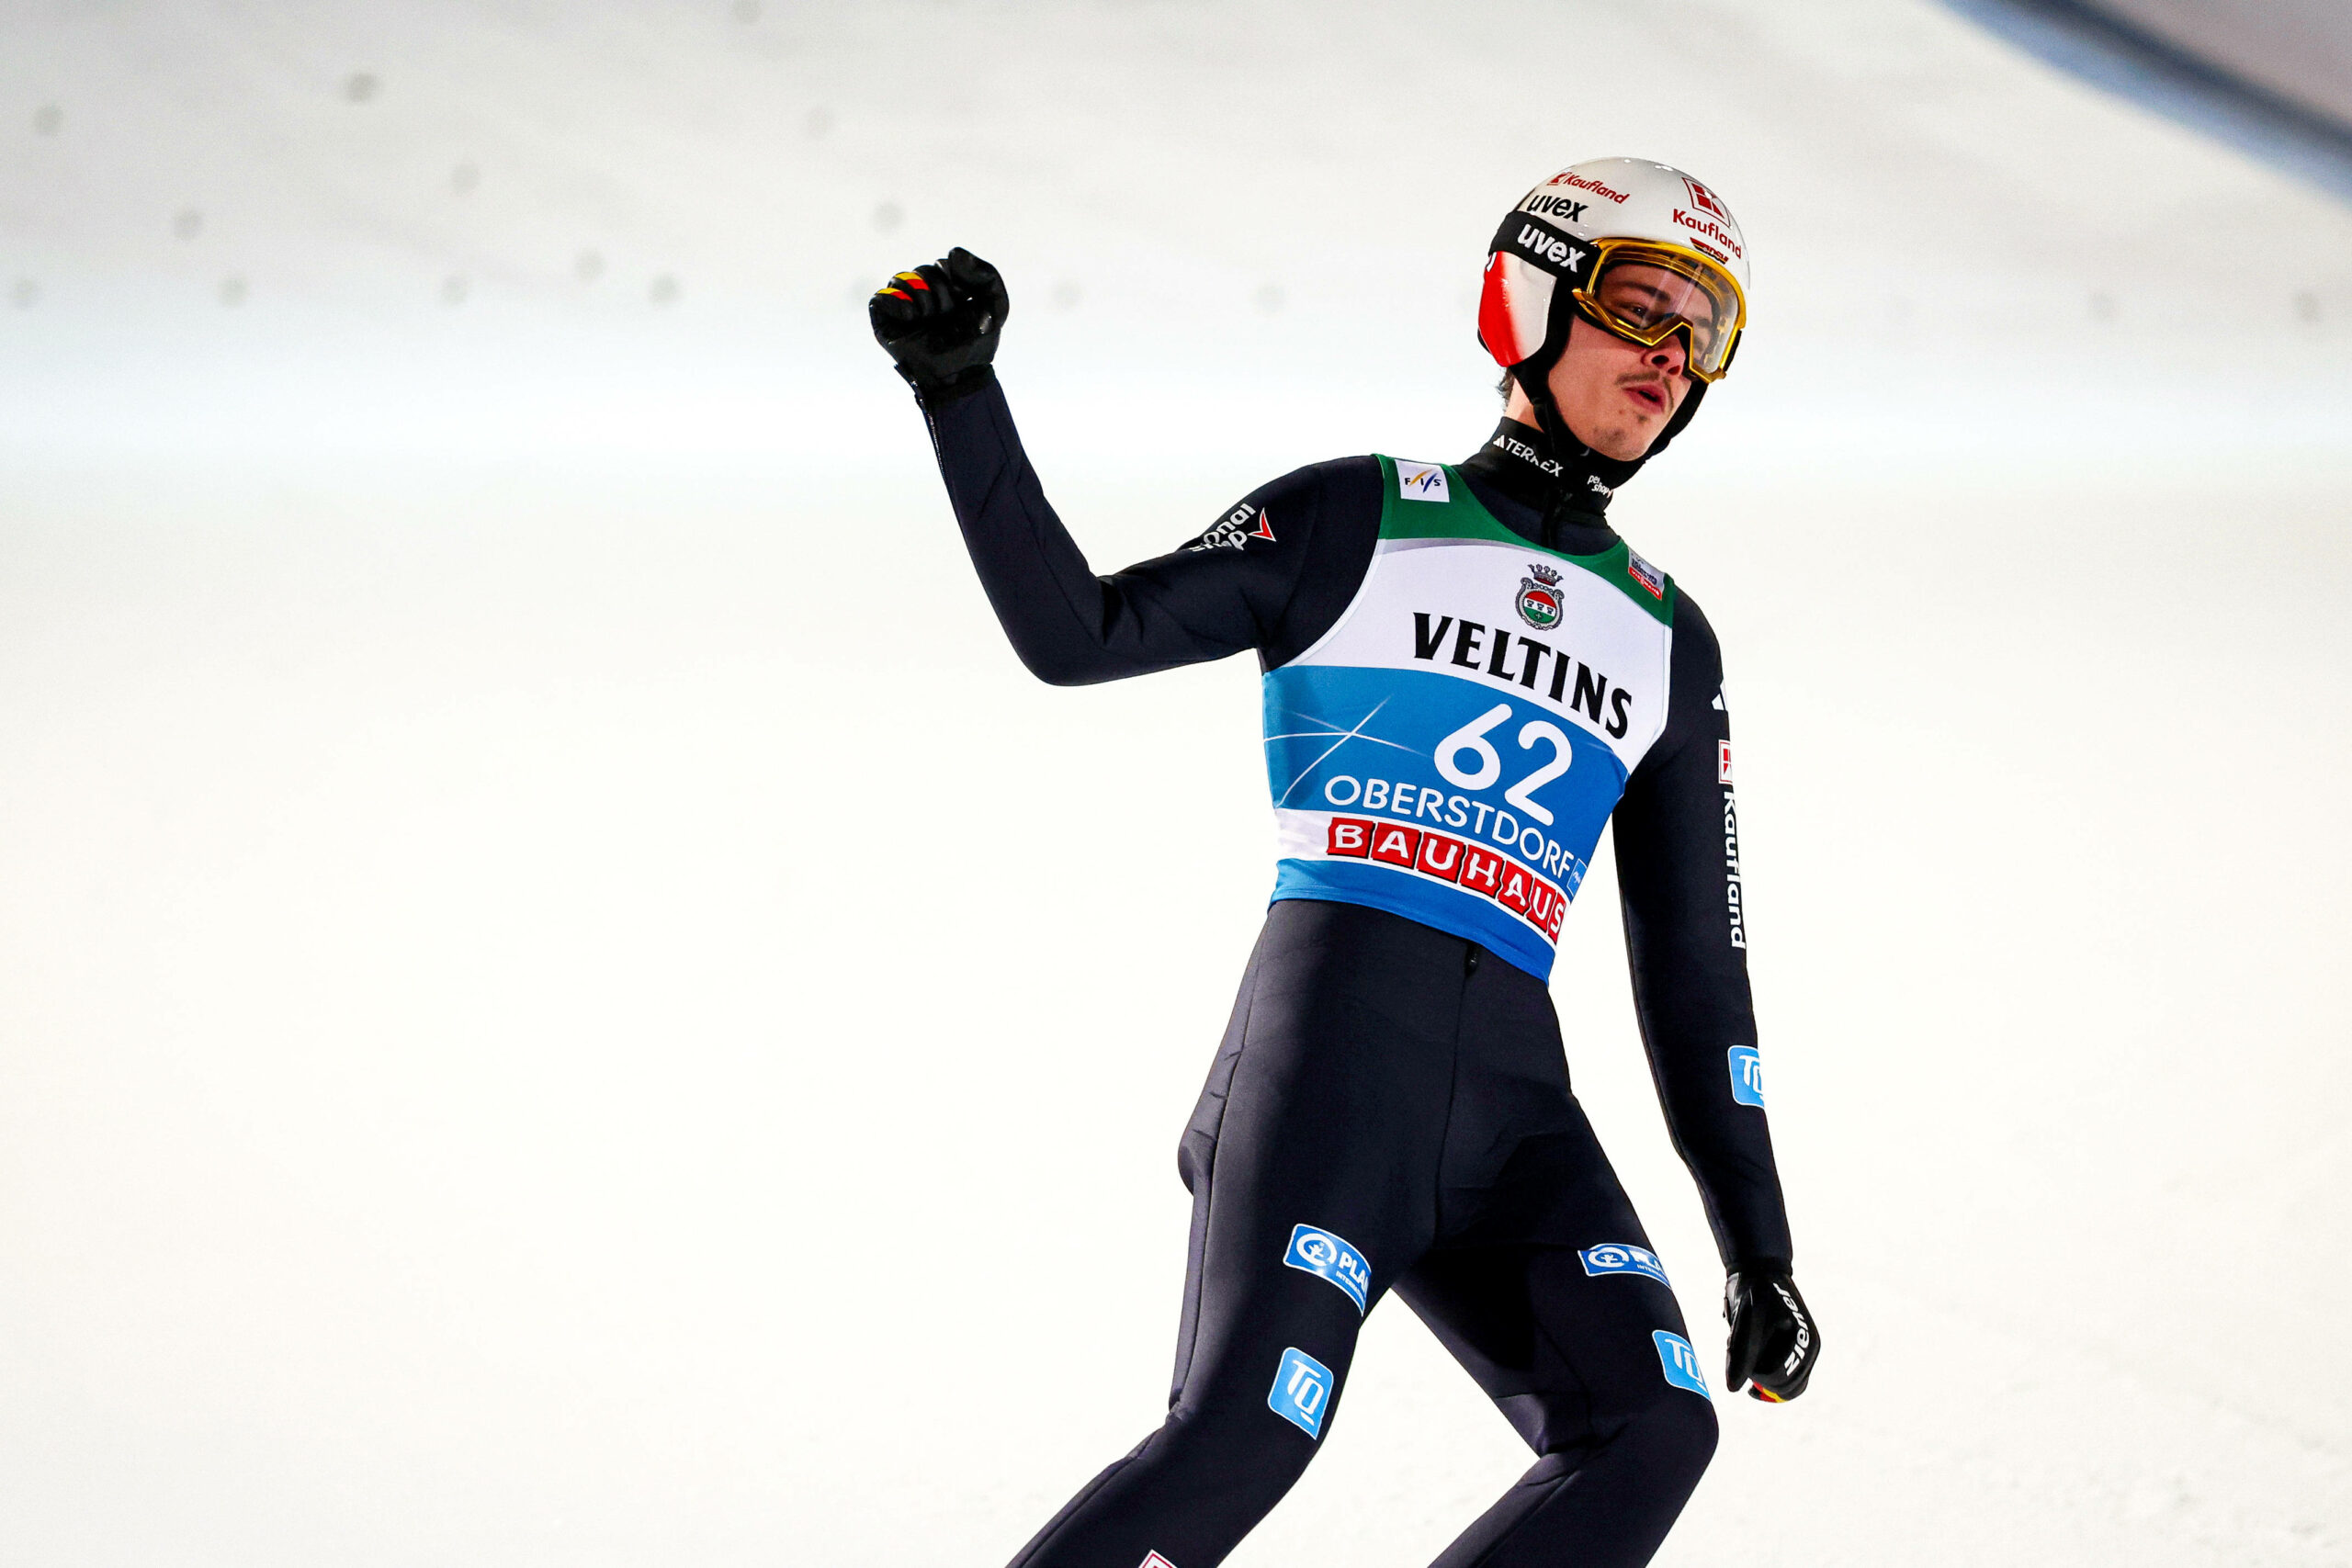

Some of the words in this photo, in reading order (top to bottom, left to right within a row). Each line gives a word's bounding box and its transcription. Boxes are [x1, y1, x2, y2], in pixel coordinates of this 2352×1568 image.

[1526, 194, 1589, 223] uvex
[1564, 173, 1631, 205] Kaufland
[1517, 223, 1588, 274] uvex
[1673, 209, 1742, 259] Kaufland
[1404, 472, 1442, 489] FIS
[1413, 612, 1633, 740] VELTINS
[1433, 703, 1573, 827] 62
[1324, 774, 1575, 879] OBERSTDORF
[1332, 822, 1565, 935] BAUHAUS
[1772, 1282, 1811, 1377] ziener
[1287, 1359, 1324, 1427] TQ
